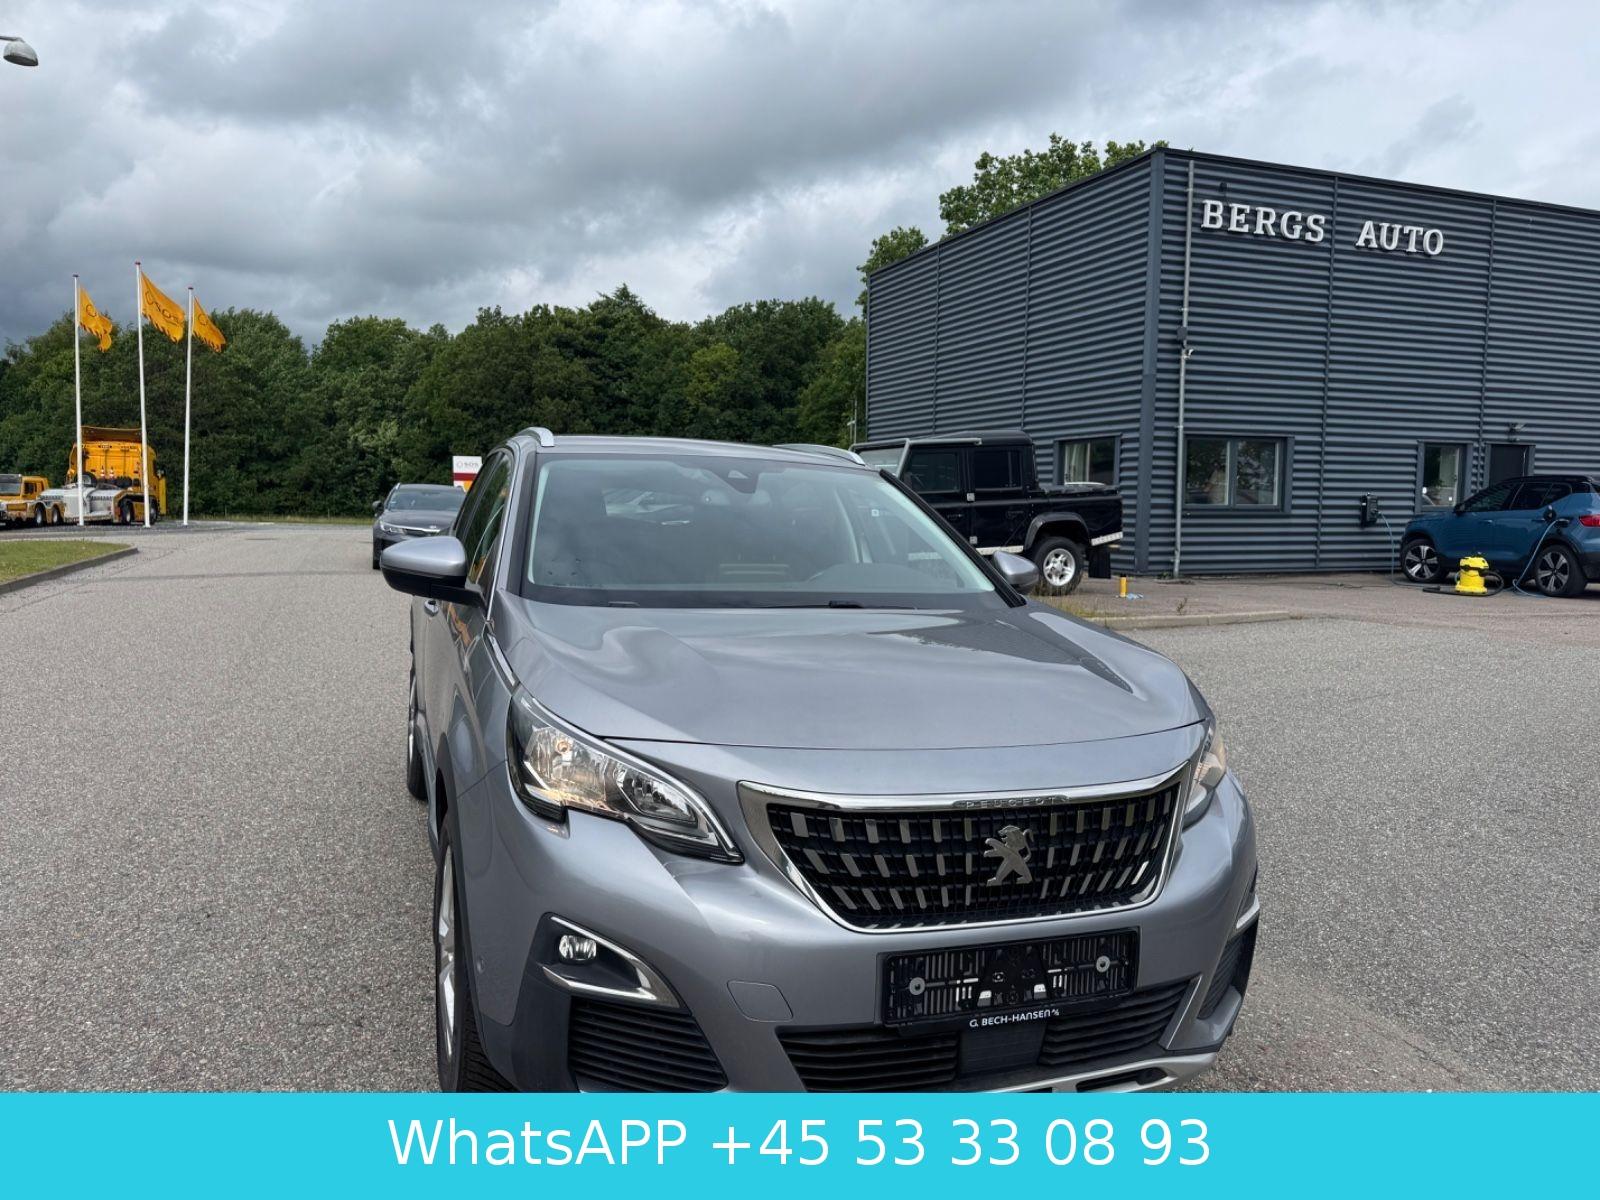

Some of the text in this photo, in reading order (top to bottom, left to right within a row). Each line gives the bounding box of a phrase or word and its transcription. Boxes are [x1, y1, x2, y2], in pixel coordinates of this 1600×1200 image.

[1201, 199, 1444, 256] BERGS AUTO
[981, 1009, 1051, 1026] BECH-HANSEN
